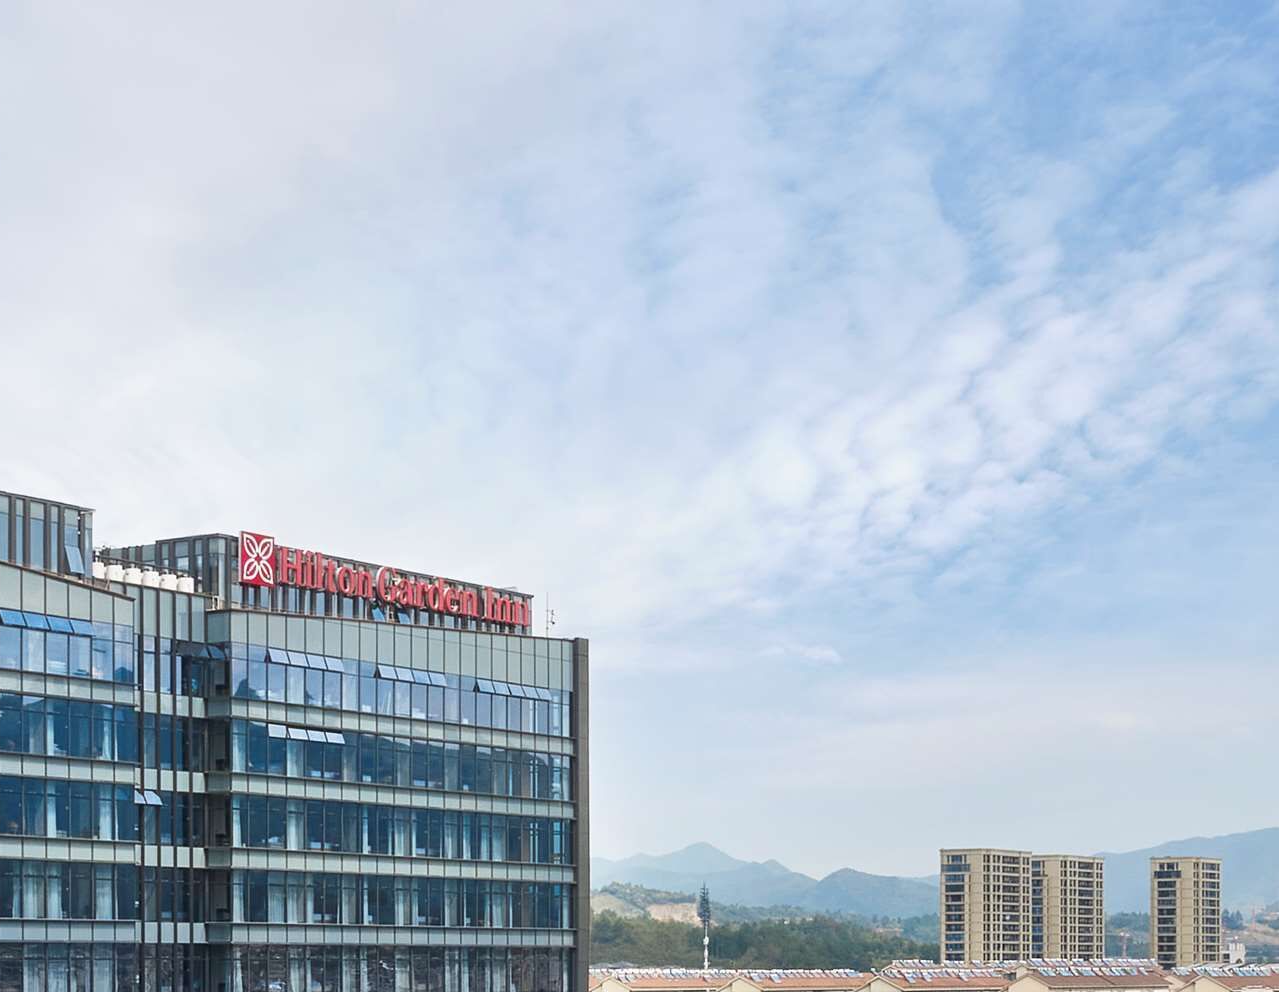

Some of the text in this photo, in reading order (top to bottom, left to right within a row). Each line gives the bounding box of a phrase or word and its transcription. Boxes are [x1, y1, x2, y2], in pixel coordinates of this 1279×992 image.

[280, 547, 529, 627] Hilton Garden Inn
